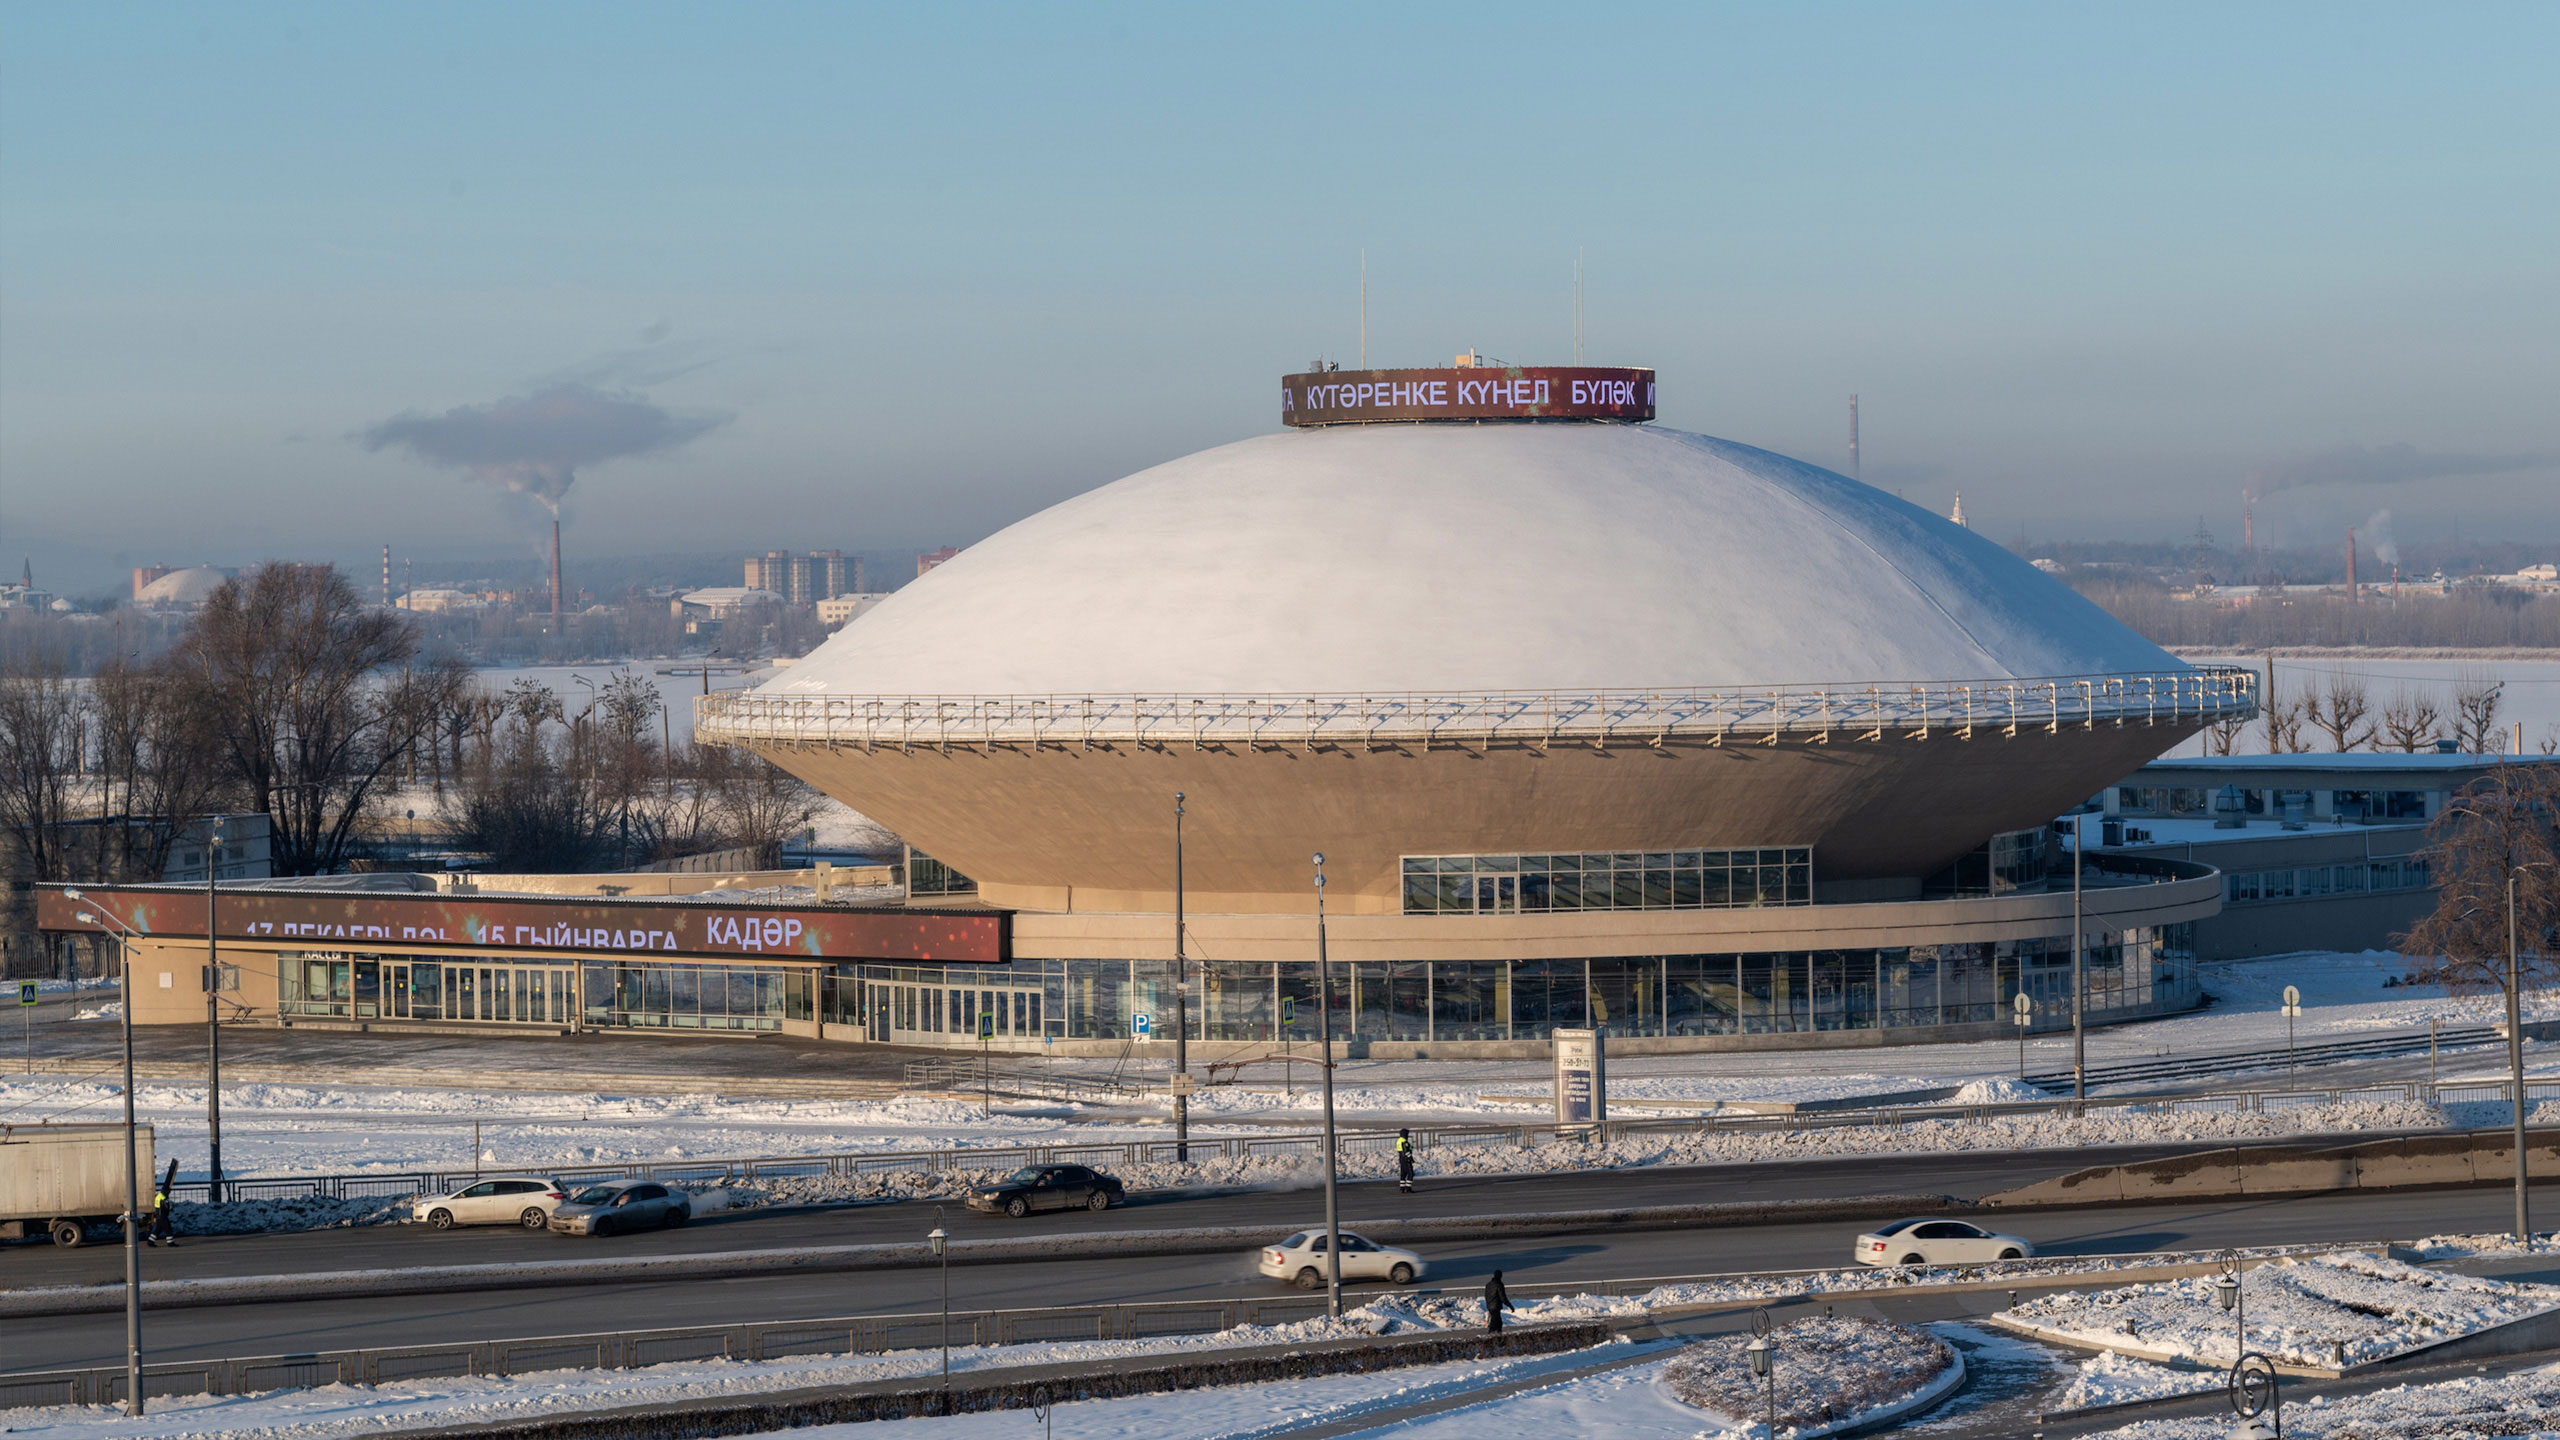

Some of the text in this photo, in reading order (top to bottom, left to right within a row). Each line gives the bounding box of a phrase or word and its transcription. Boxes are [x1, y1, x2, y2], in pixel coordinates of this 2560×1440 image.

[1307, 381, 1448, 410] КҮТӘРЕНКЕ
[1458, 379, 1549, 408] КҮҢЕЛ
[1571, 380, 1636, 405] БҮЛӘК
[707, 916, 803, 951] КАДӘР
[1136, 1015, 1148, 1033] P
